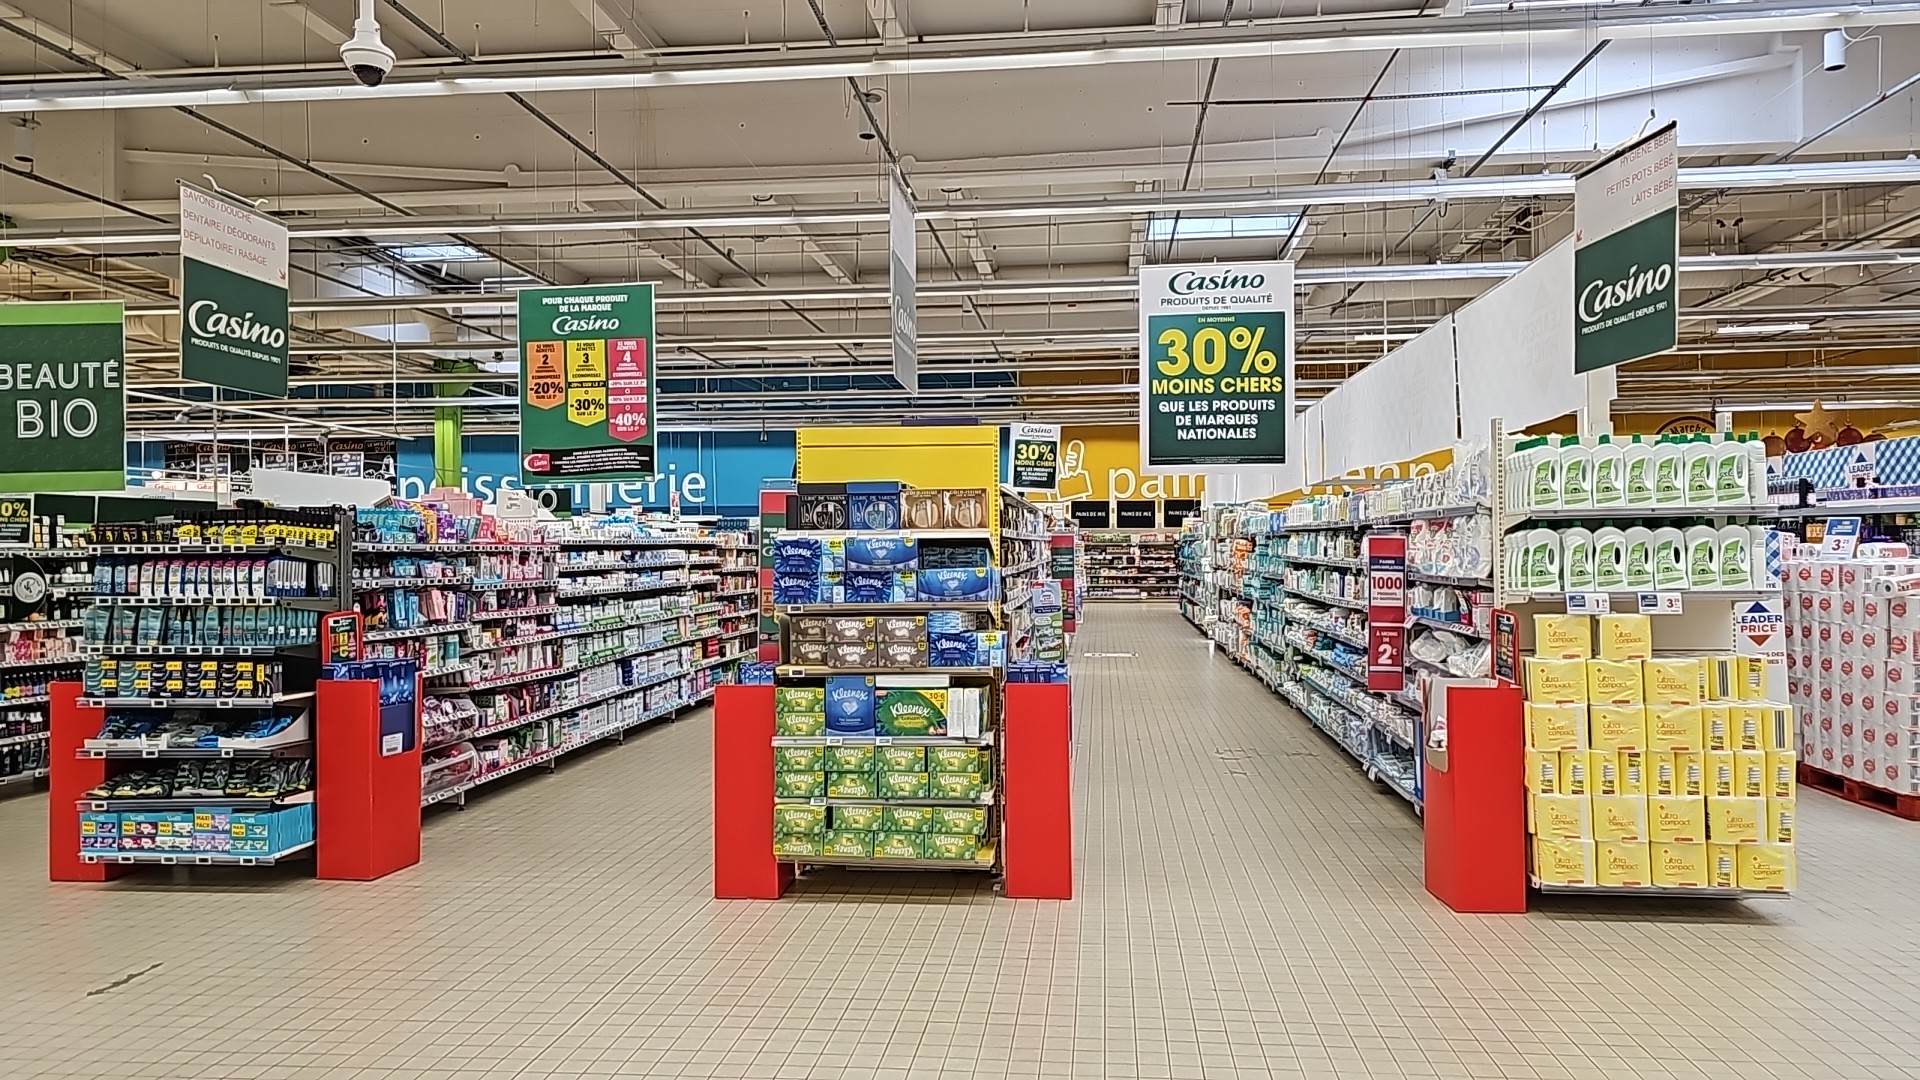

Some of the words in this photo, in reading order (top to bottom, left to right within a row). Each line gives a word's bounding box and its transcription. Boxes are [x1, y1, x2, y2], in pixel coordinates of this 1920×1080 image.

[1606, 177, 1631, 196] PETITS
[1632, 169, 1653, 190] POTS
[1631, 187, 1652, 206] LAITS
[183, 188, 215, 209] SAVONS
[221, 204, 252, 224] DOUCHE
[183, 209, 221, 231] DENTAIRE
[239, 249, 267, 266] RASAGE
[1168, 269, 1265, 295] Casino
[542, 297, 562, 305] POUR
[564, 296, 594, 304] CHAQUE
[595, 294, 628, 303] PRODUIT
[1160, 296, 1210, 306] PRODUITS
[1213, 295, 1227, 304] DE
[1230, 293, 1273, 304] QUALITÉ
[1578, 264, 1671, 323] Casino
[188, 300, 285, 348] Casino
[552, 315, 620, 335] Casino
[1582, 321, 1605, 335] PRODUITS
[1605, 318, 1613, 328] DE
[1613, 309, 1635, 326] QUALITÉ
[1636, 305, 1655, 318] DEPUIS
[191, 337, 220, 350] PRODUITS
[220, 344, 228, 352] DE
[229, 346, 252, 357] QUALITÉ
[252, 352, 269, 361] DEPUIS
[1157, 326, 1277, 376] 30%
[542, 354, 549, 365] 2
[583, 353, 589, 363] 3
[623, 351, 631, 363] 4
[0, 359, 120, 390] BEAUTÉ
[529, 382, 563, 394] -20%
[1152, 378, 1215, 395] MOINS
[1220, 376, 1282, 394] CHERS
[570, 398, 604, 410] -30%
[1158, 401, 1185, 412] QUE
[1189, 401, 1209, 412] LES
[1212, 400, 1275, 411] PRODUITS
[17, 398, 98, 438] BIO
[609, 413, 646, 425] -40%
[1176, 415, 1192, 426] DE
[1195, 414, 1259, 426] MARQUES
[1022, 426, 1052, 434] Casino
[1177, 428, 1256, 440] NATIONALES
[329, 441, 364, 452] Casino
[1017, 444, 1054, 460] 30%
[1849, 464, 1874, 473] LEADER
[1832, 539, 1841, 551] 3
[781, 545, 813, 558] Kleenex
[779, 576, 811, 588] Kleenex
[852, 576, 883, 588] Kleenex
[1372, 576, 1402, 590] 1000
[1594, 599, 1599, 608] 1
[1666, 599, 1674, 608] 3
[886, 620, 916, 630] Kleenex
[1736, 615, 1782, 623] LEADER
[836, 620, 865, 631] Kleenex
[1741, 624, 1777, 633] PRICE
[800, 643, 828, 654] Kleenex
[837, 644, 867, 656] Kleenex
[888, 644, 917, 656] Kleenex
[936, 639, 968, 651] Kleenex
[785, 689, 814, 701] Kleenex
[832, 688, 868, 701] Kleenex
[890, 702, 930, 717] Kleenex
[786, 715, 815, 726] Kleenex
[785, 748, 814, 759] Kleenex
[834, 747, 864, 759] Kleenex
[885, 748, 914, 759] Kleenex
[937, 748, 967, 760] Kleenex
[785, 774, 814, 785] Kleenex
[889, 774, 919, 785] Kleenex
[940, 774, 970, 786] Kleenex
[784, 810, 814, 821] Kleenex
[843, 807, 873, 818] Kleenex
[893, 808, 923, 820] Kleenex
[943, 809, 973, 821] Kleenex
[1660, 812, 1678, 820] ultra
[935, 835, 965, 847] Kleenex
